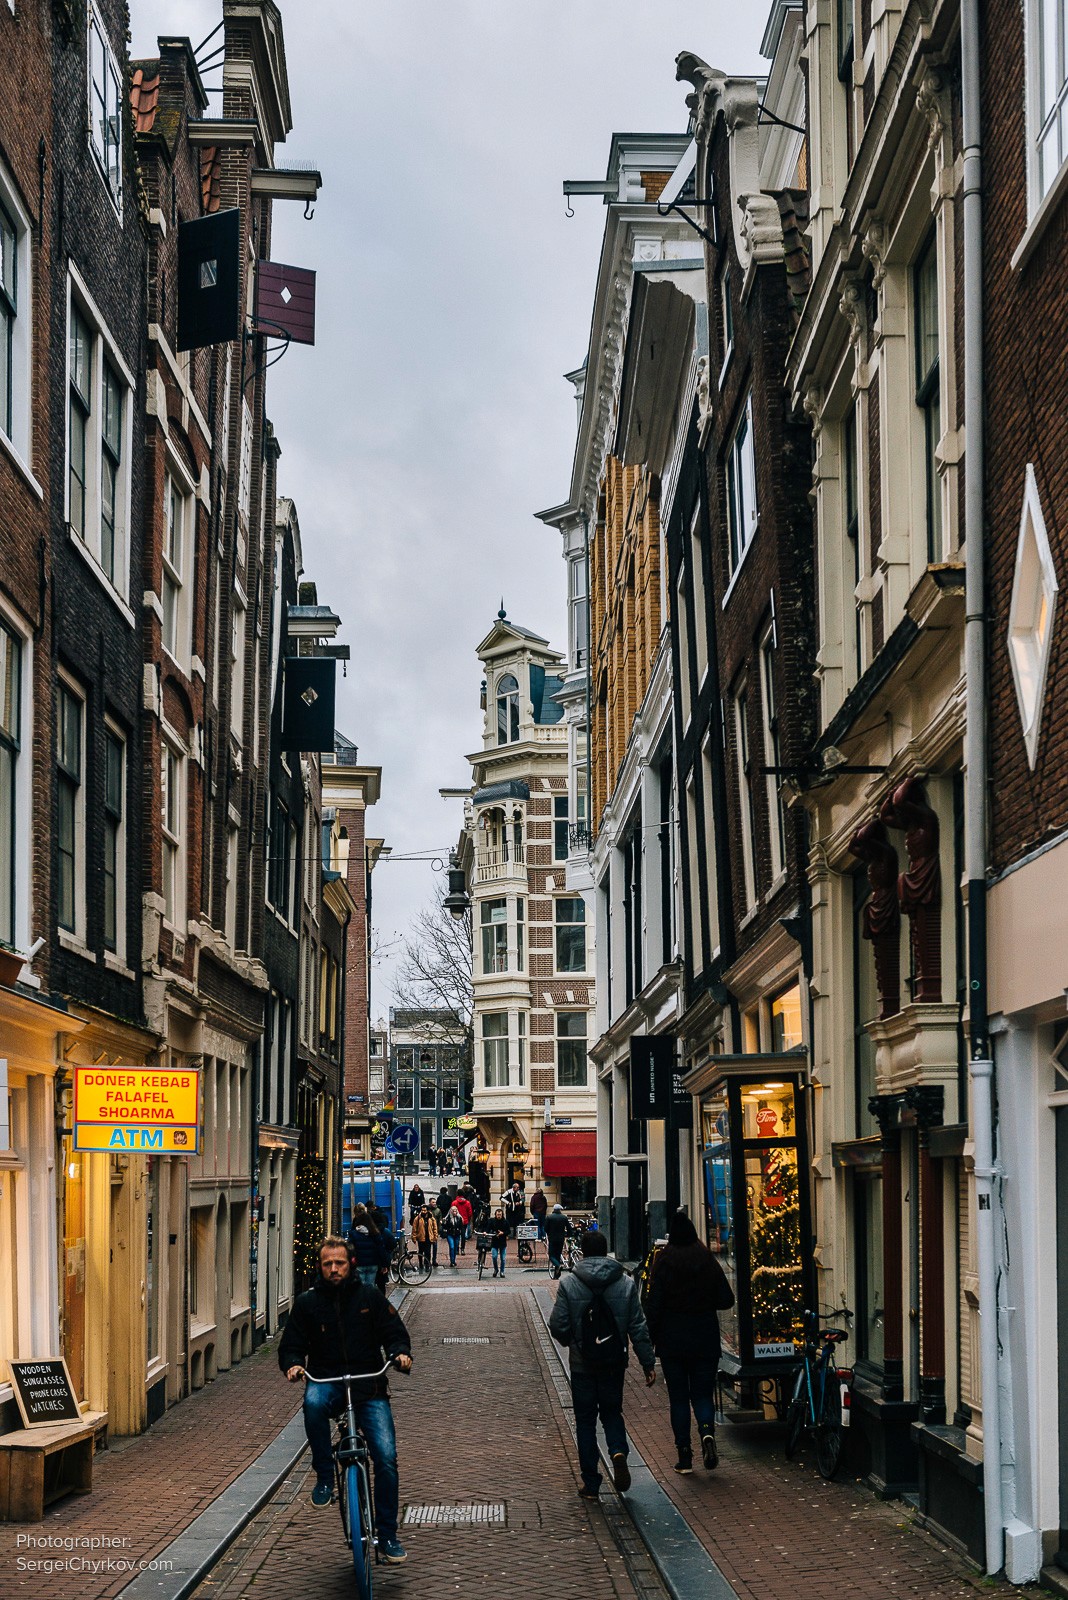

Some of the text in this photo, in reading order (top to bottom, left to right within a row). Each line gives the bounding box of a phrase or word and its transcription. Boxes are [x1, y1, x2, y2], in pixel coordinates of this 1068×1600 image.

[84, 1073, 190, 1088] DÖNER KEBAB
[106, 1091, 168, 1103] FALAFEL
[99, 1107, 175, 1119] SHOARMA
[109, 1128, 164, 1147] ATM
[757, 1346, 781, 1354] WALK
[18, 1365, 52, 1375] WOODEN
[23, 1375, 65, 1387] SUNGLASSES
[29, 1388, 68, 1399] PHONE CASES
[30, 1400, 65, 1413] WATCHES
